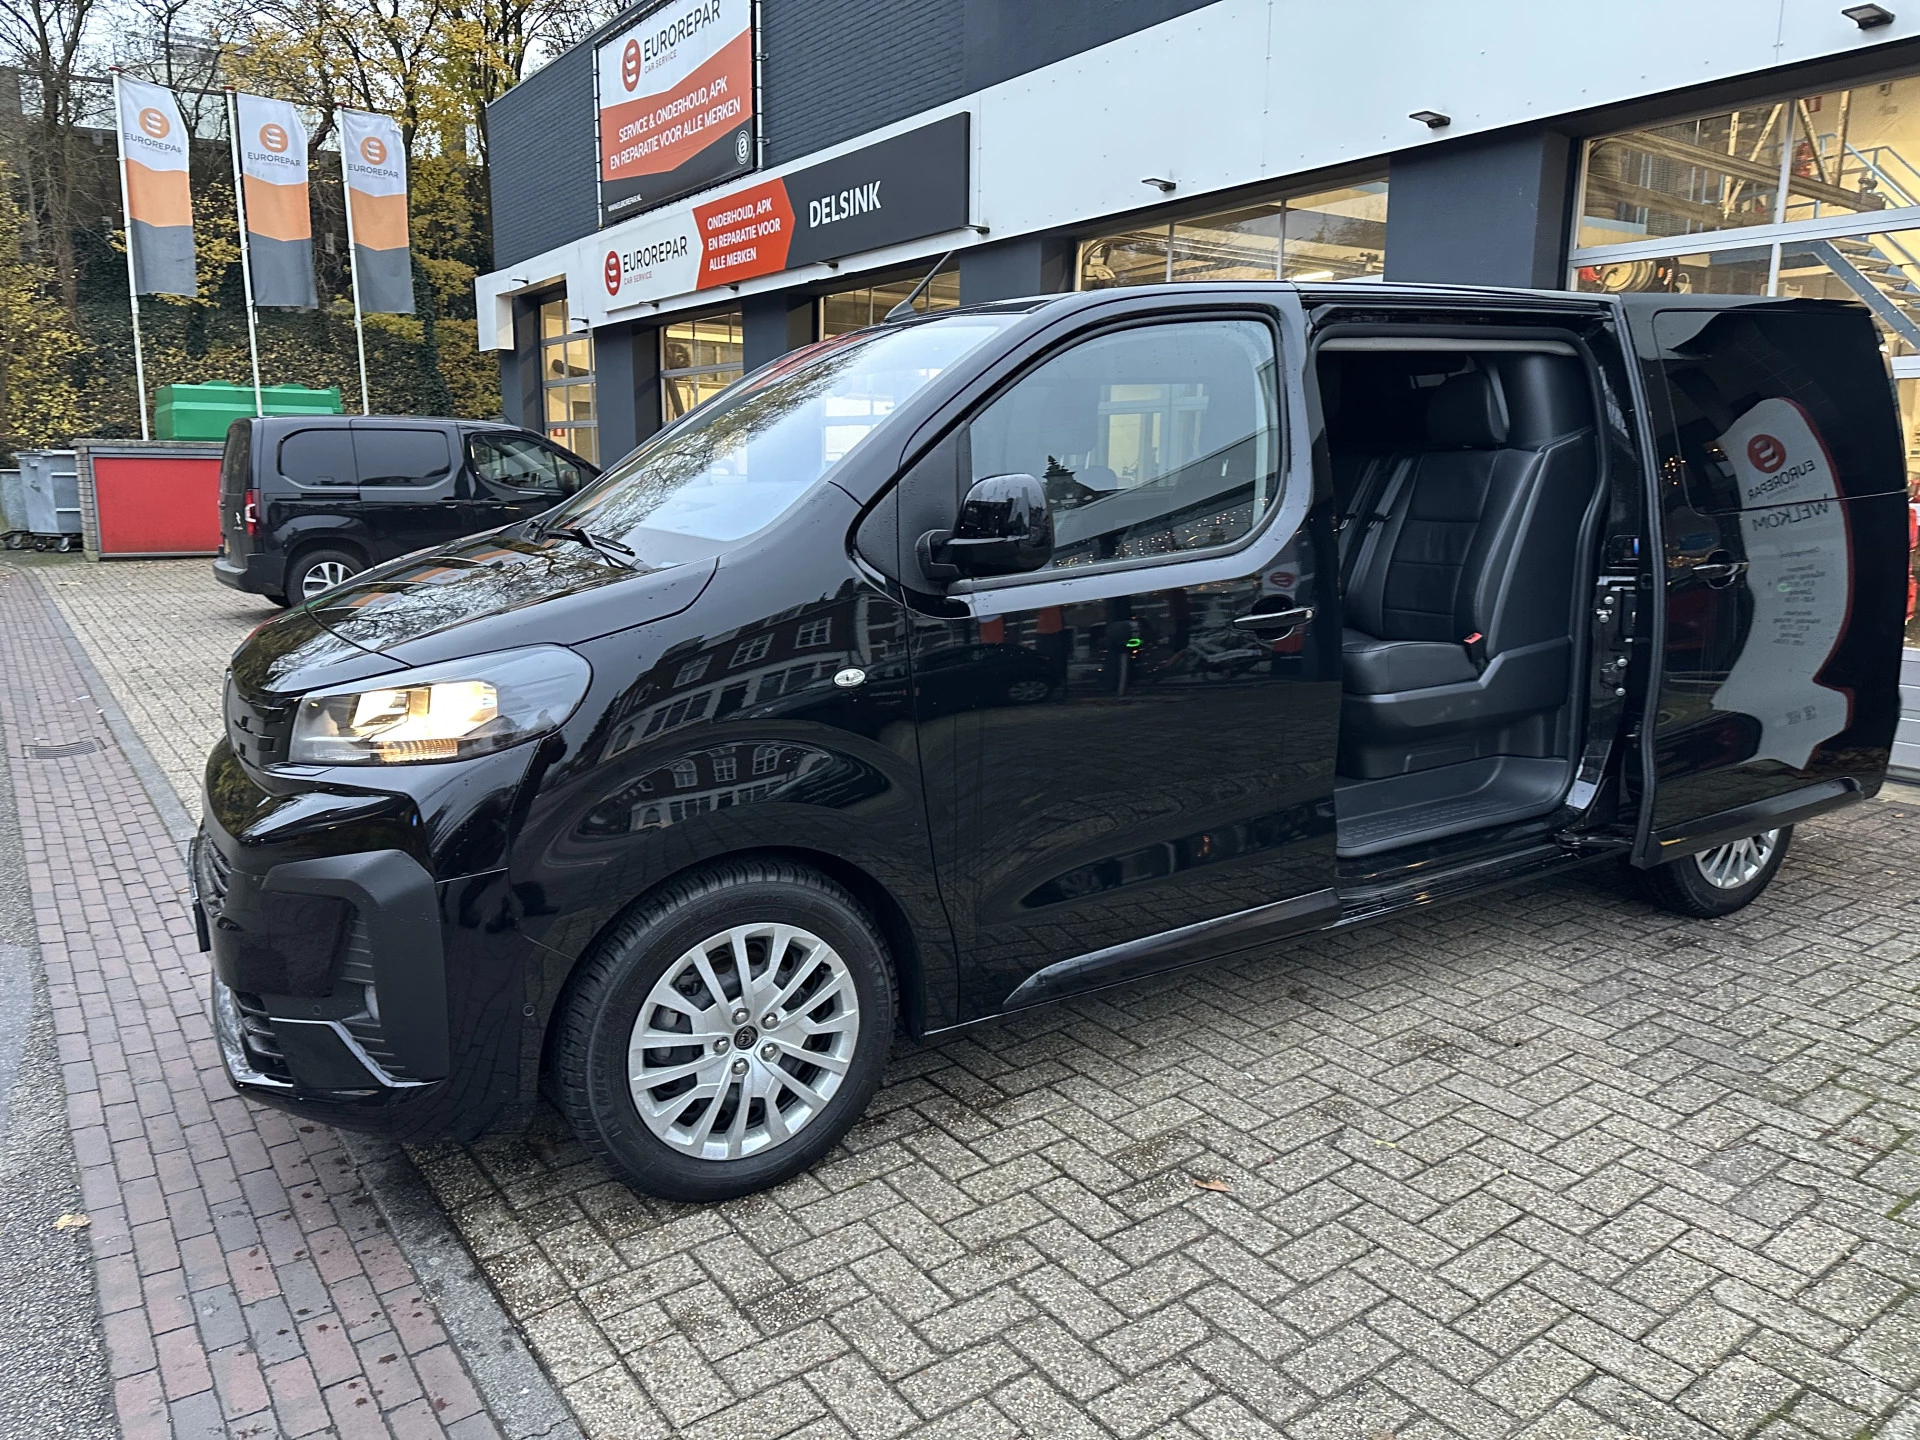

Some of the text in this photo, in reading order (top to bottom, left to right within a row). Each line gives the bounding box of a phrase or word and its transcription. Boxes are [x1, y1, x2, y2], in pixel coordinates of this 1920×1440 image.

[643, 0, 721, 62] EUROREPAR
[644, 49, 677, 74] CAR SERVICE
[618, 75, 728, 143] SERVICE & ONDERHOUD, APK
[610, 96, 741, 170] EN REPARATIE VOOR ALLE MERKEN
[247, 151, 301, 167] EUROREPAR
[347, 163, 399, 179] EUROREPAR
[707, 197, 773, 232] ONDERHOUD, APK
[809, 180, 882, 229] DELSINK
[708, 217, 781, 251] EN REPARATIE VOOR
[622, 235, 688, 274] EUROREPAR
[709, 246, 757, 272] ALLE MERKEN
[623, 270, 653, 286] CAR SERVICE
